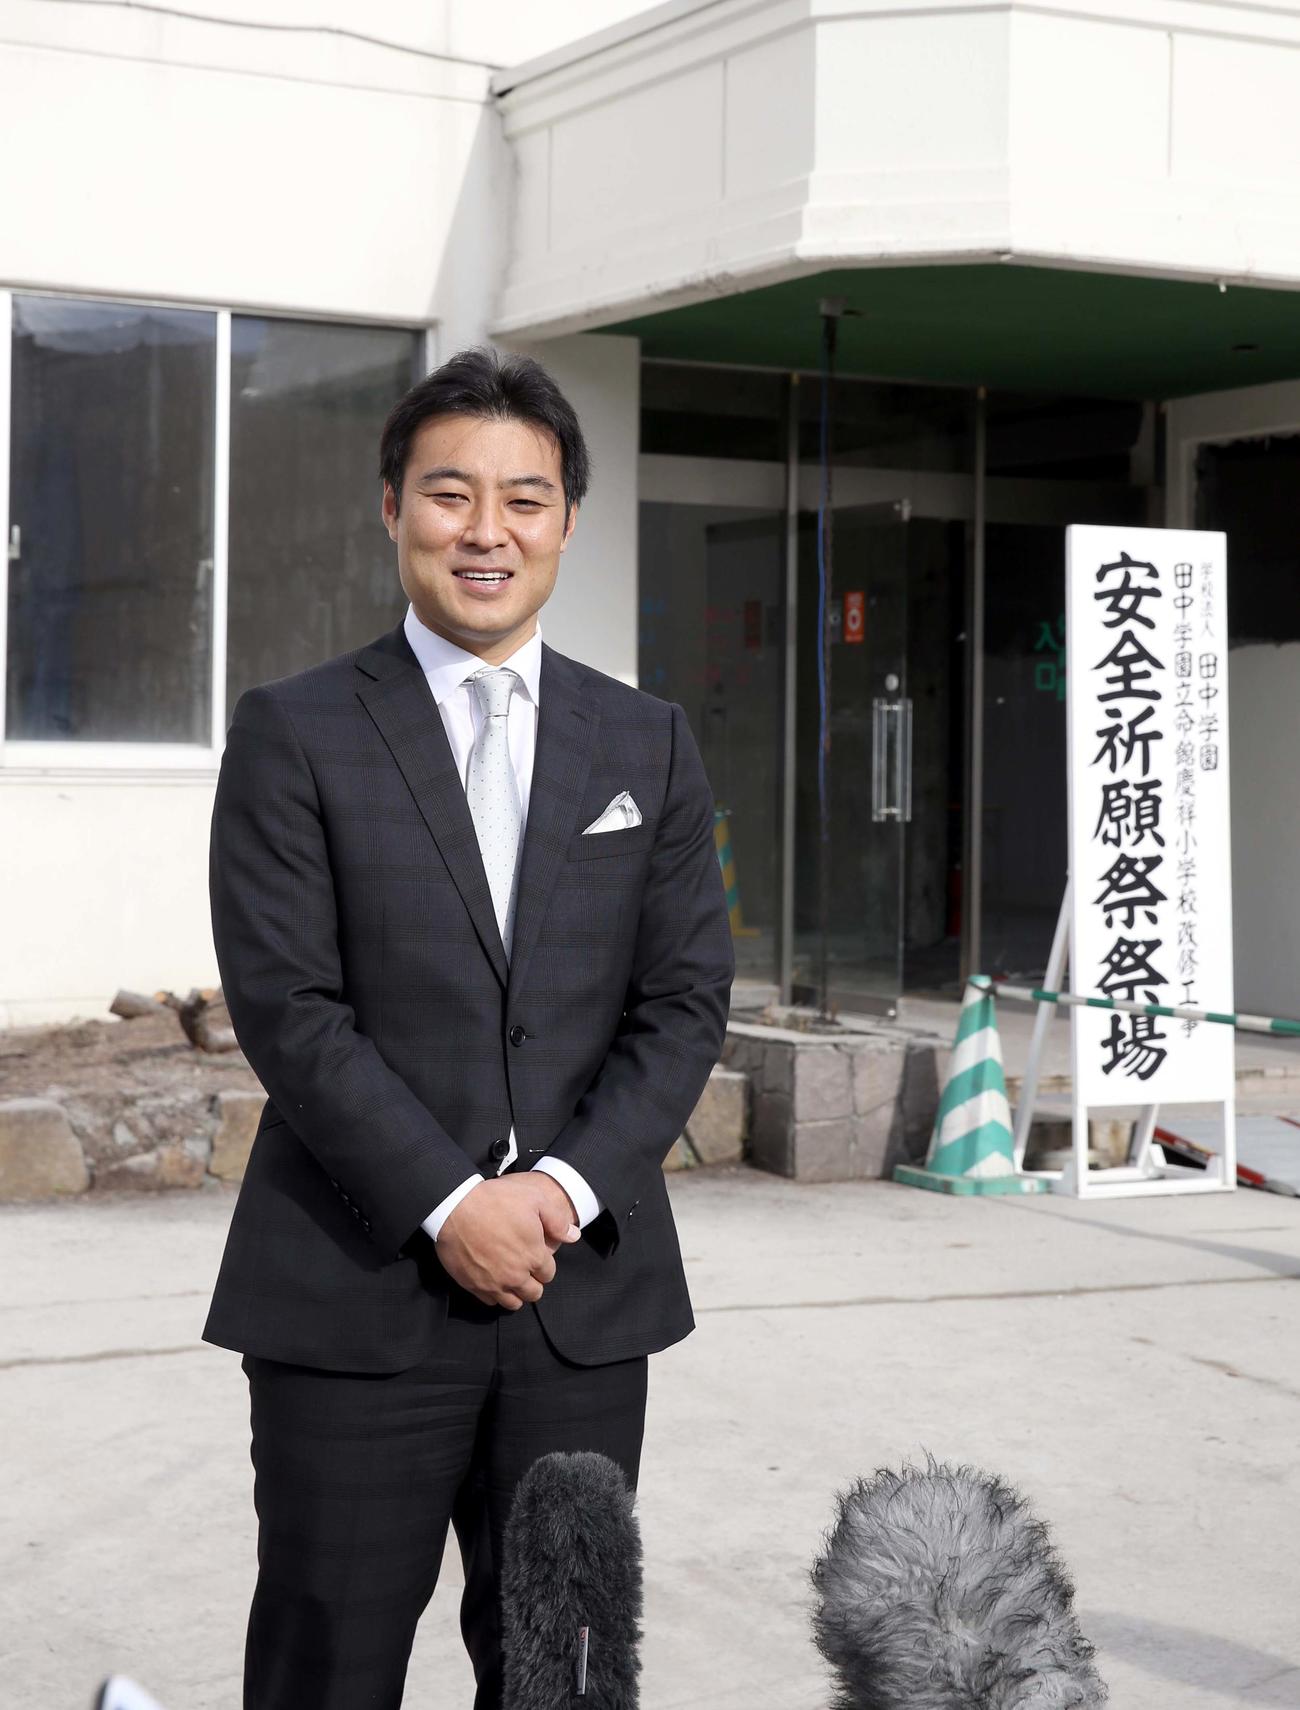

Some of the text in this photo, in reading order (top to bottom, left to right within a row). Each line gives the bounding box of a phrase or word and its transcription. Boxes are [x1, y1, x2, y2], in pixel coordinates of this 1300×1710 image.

[1091, 551, 1171, 1081] 安全祈願祭祭場
[1198, 652, 1219, 772] 田中学園
